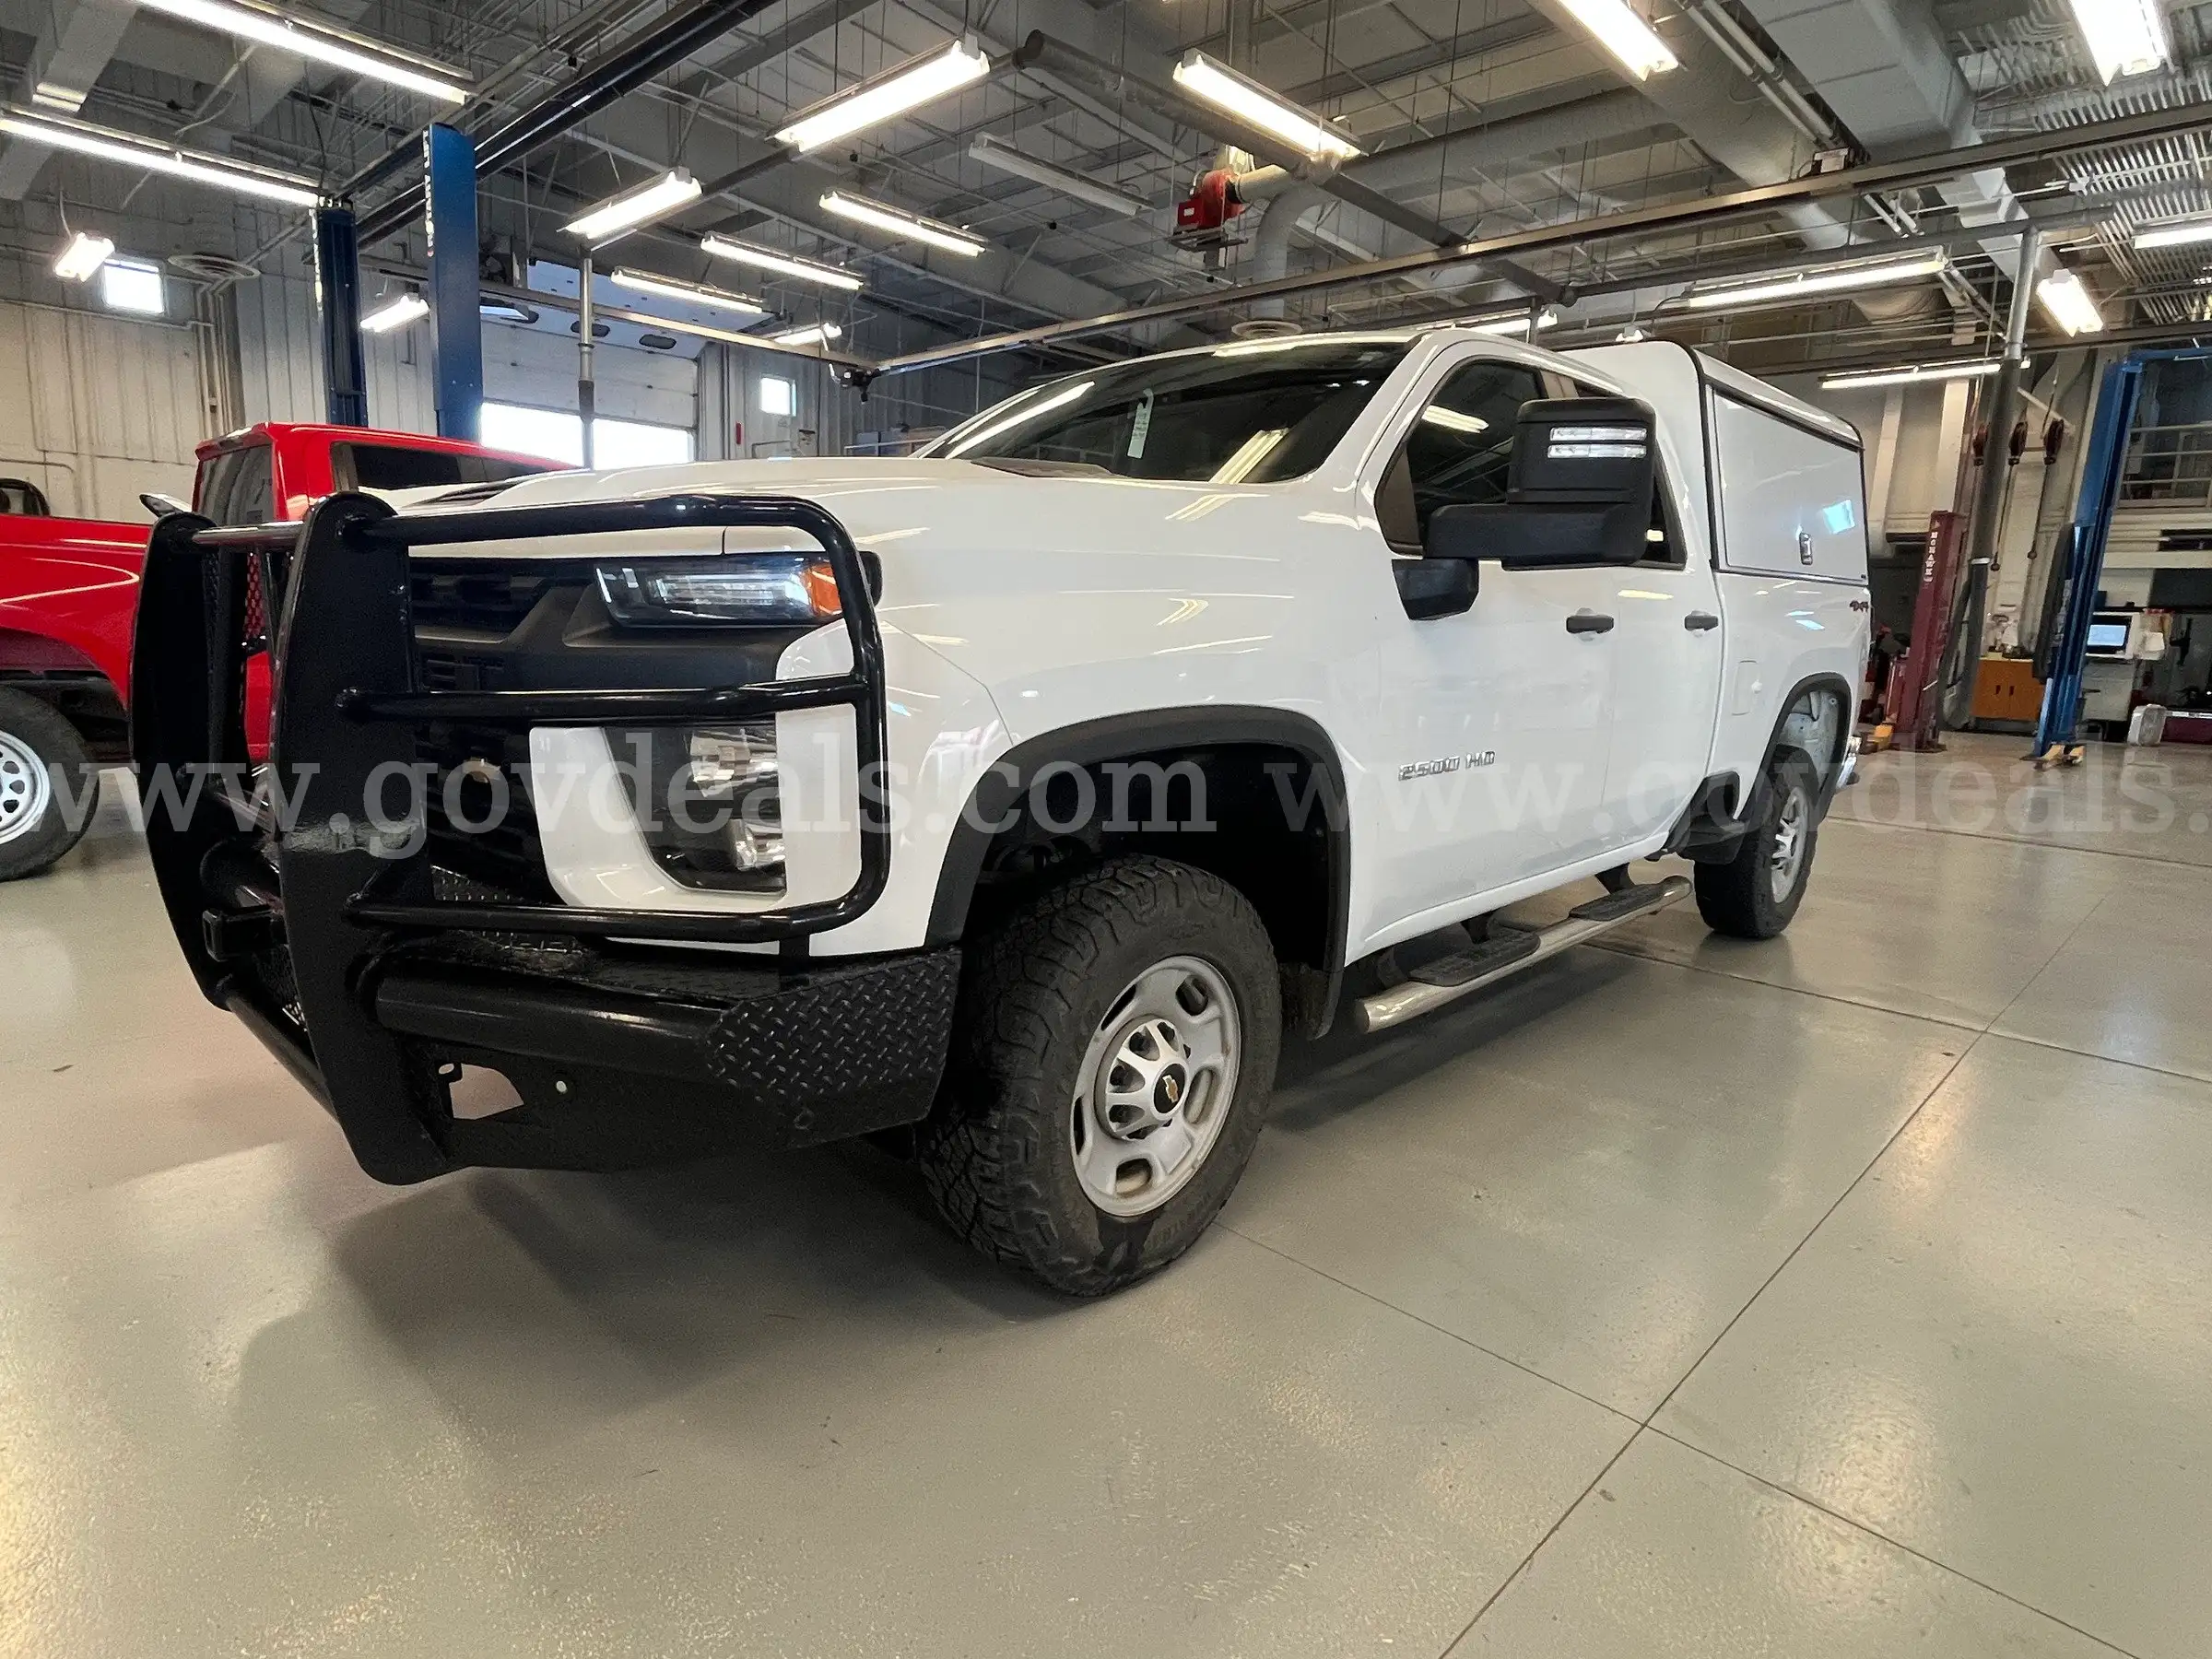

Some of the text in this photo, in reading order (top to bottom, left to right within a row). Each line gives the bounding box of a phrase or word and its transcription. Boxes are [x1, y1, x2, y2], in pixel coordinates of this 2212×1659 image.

[1924, 531, 1938, 576] MOHAWK
[1398, 750, 1495, 781] 2500 HD
